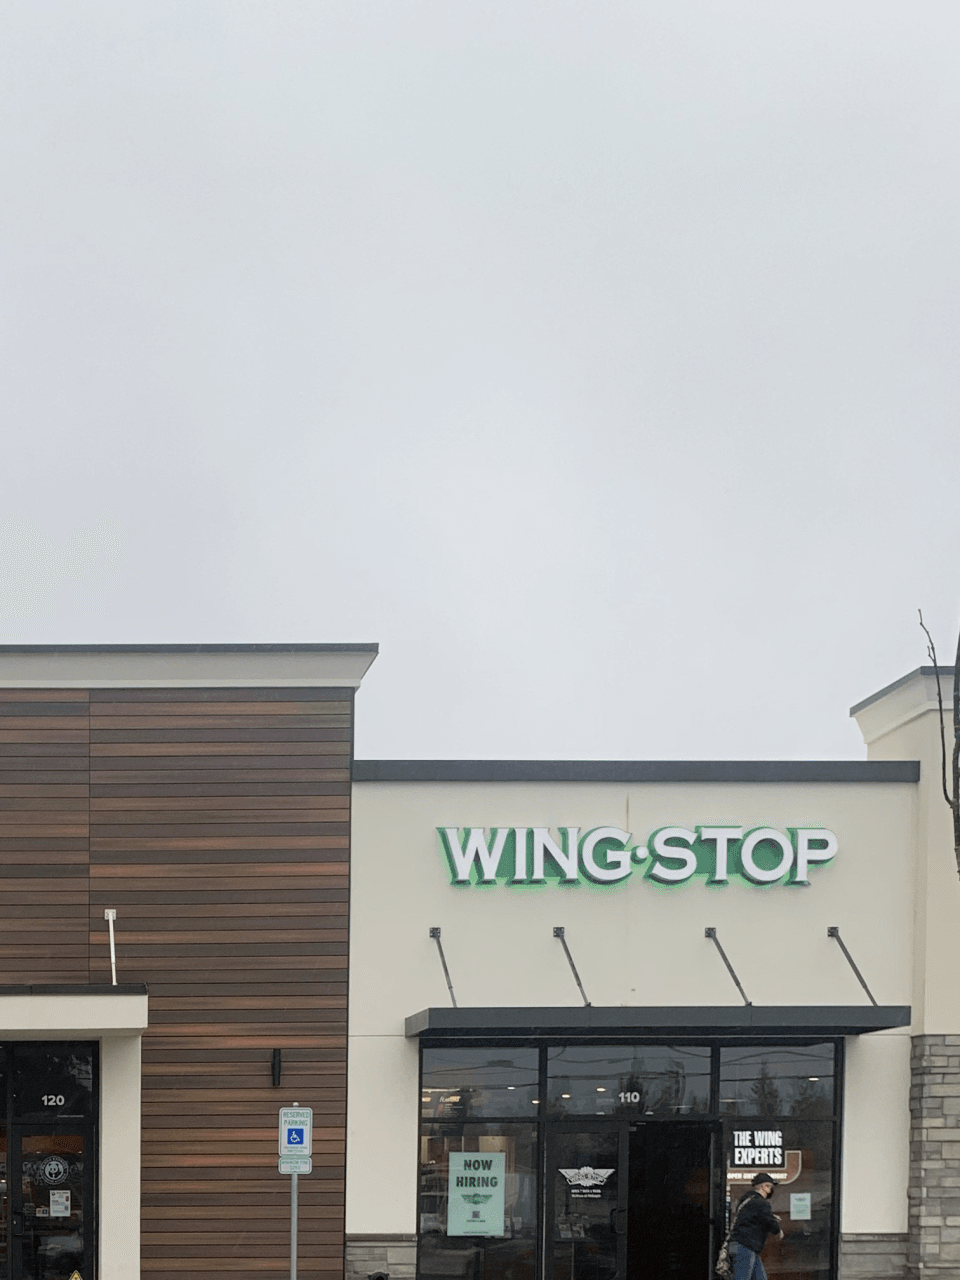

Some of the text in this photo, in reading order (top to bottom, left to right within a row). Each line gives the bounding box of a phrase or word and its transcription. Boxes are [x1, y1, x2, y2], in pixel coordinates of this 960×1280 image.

[41, 1095, 65, 1106] 120
[619, 1092, 640, 1103] 110
[733, 1131, 782, 1146] THE WING
[735, 1148, 782, 1164] EXPERTS
[464, 1160, 492, 1171] NOW
[456, 1177, 498, 1188] HIRING
